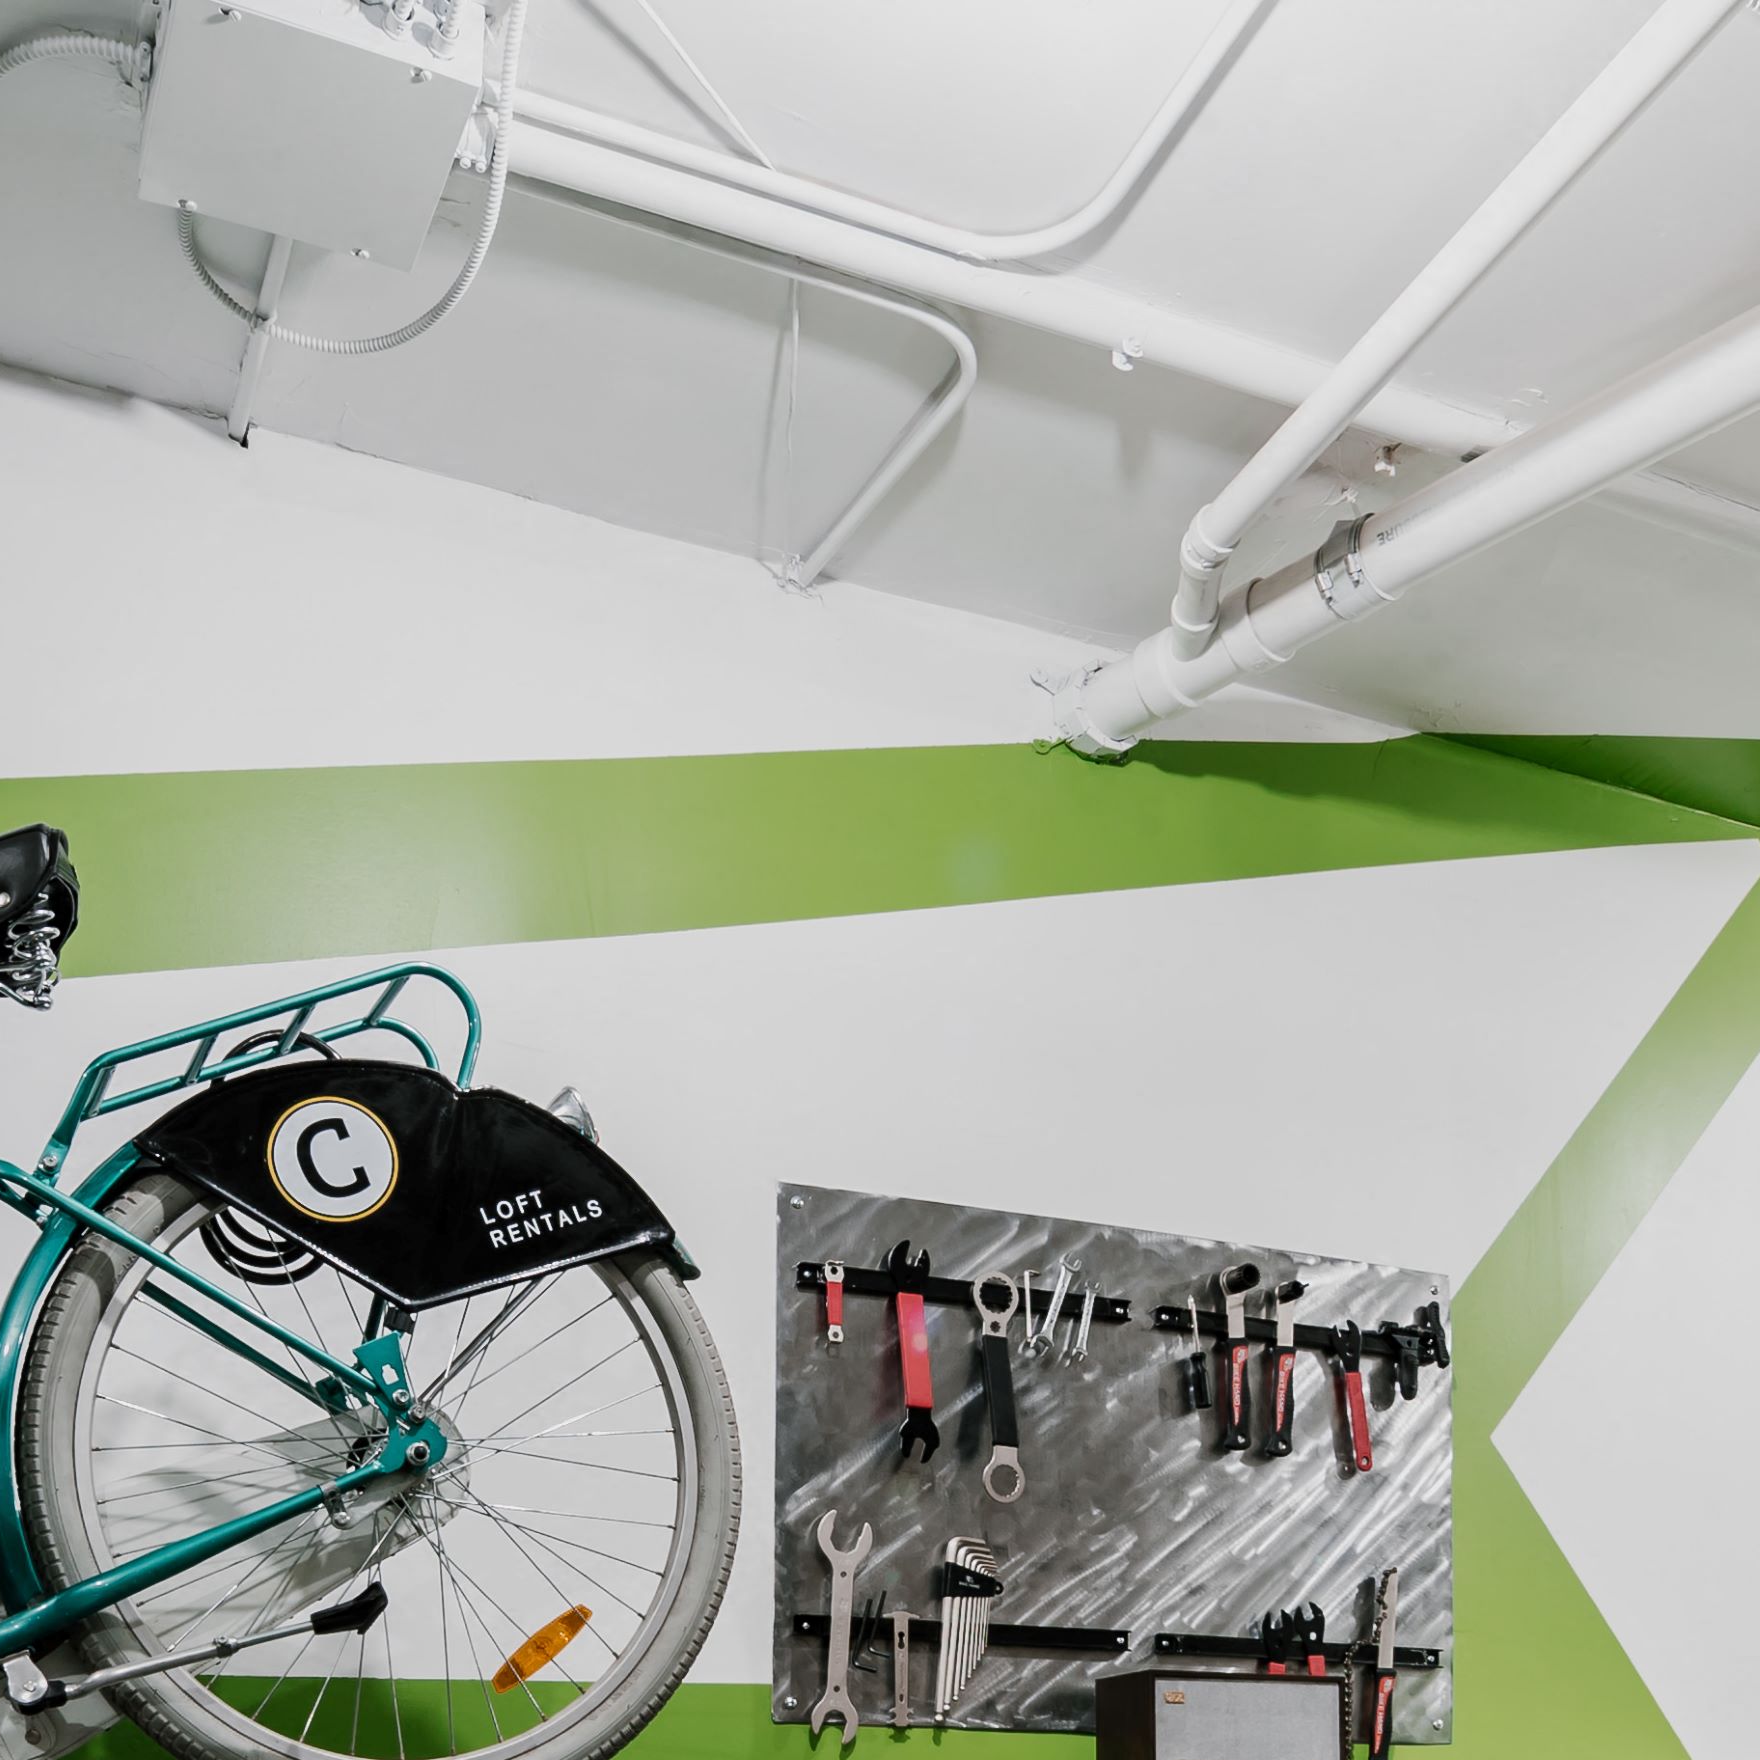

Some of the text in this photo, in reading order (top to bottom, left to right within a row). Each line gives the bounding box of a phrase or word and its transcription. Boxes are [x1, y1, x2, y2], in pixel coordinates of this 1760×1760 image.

[296, 1117, 371, 1198] C
[479, 1189, 543, 1225] LOFT
[489, 1199, 603, 1249] RENTALS
